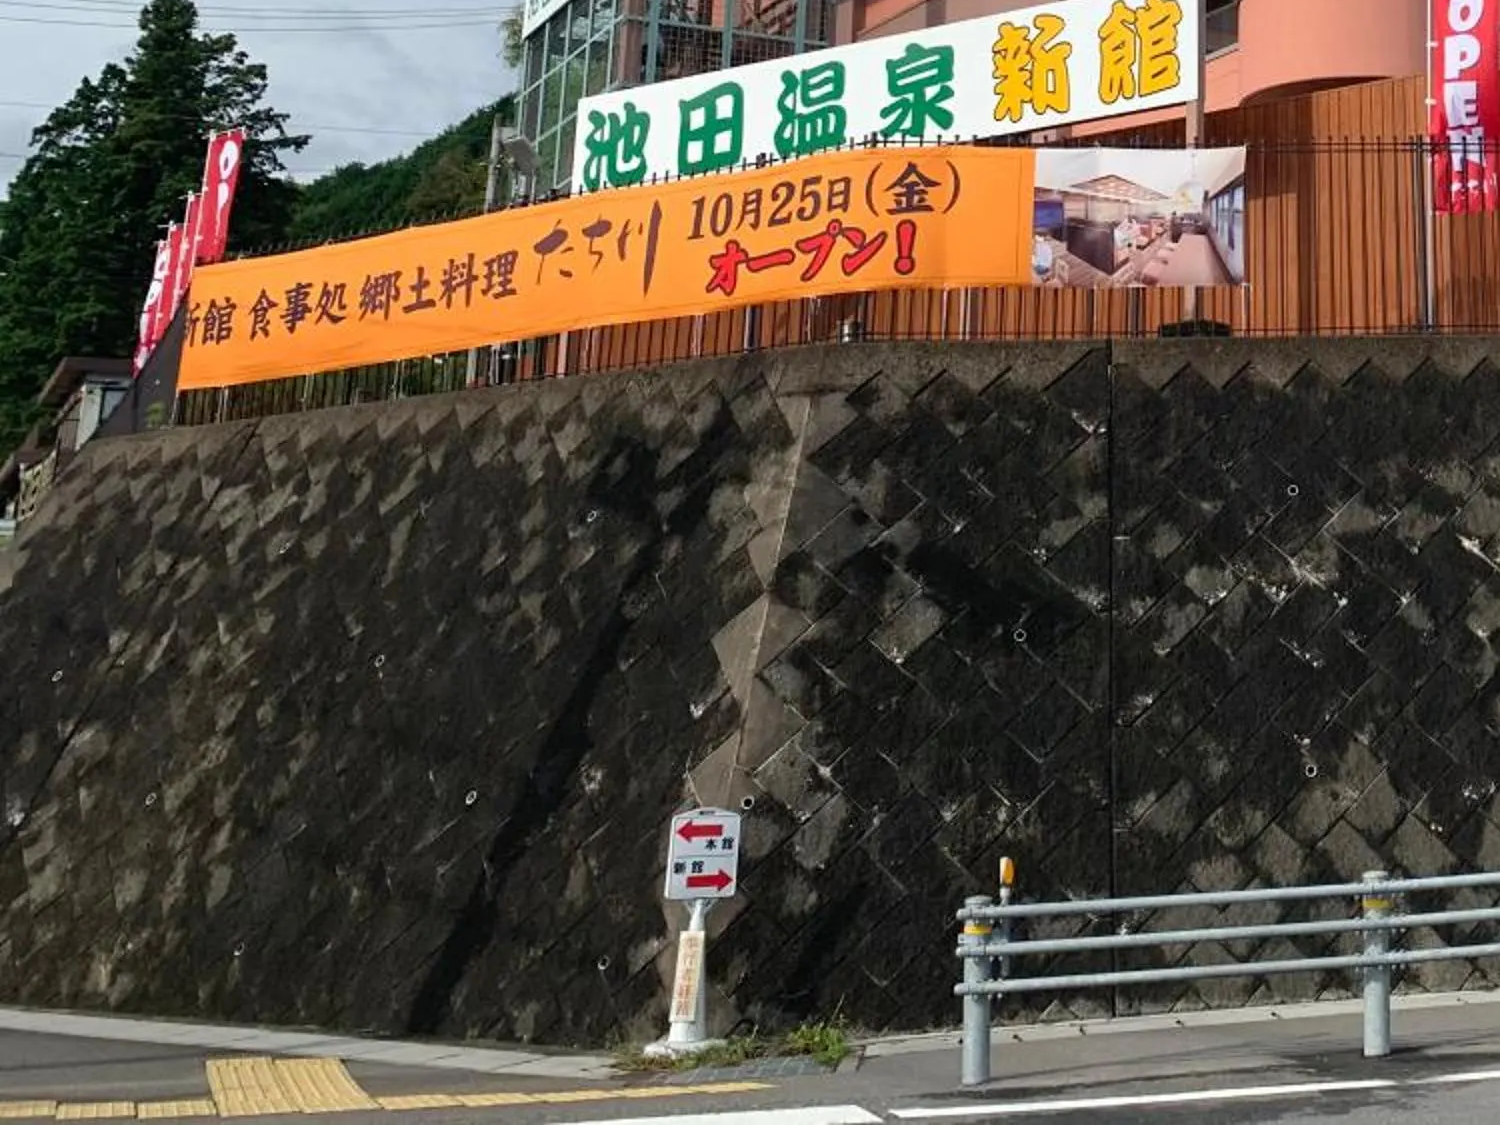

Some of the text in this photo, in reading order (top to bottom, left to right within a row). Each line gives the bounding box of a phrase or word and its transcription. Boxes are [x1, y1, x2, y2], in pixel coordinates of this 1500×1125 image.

[249, 281, 347, 341] 食事処
[358, 249, 519, 321] 郷土料理
[704, 836, 735, 851] 本館
